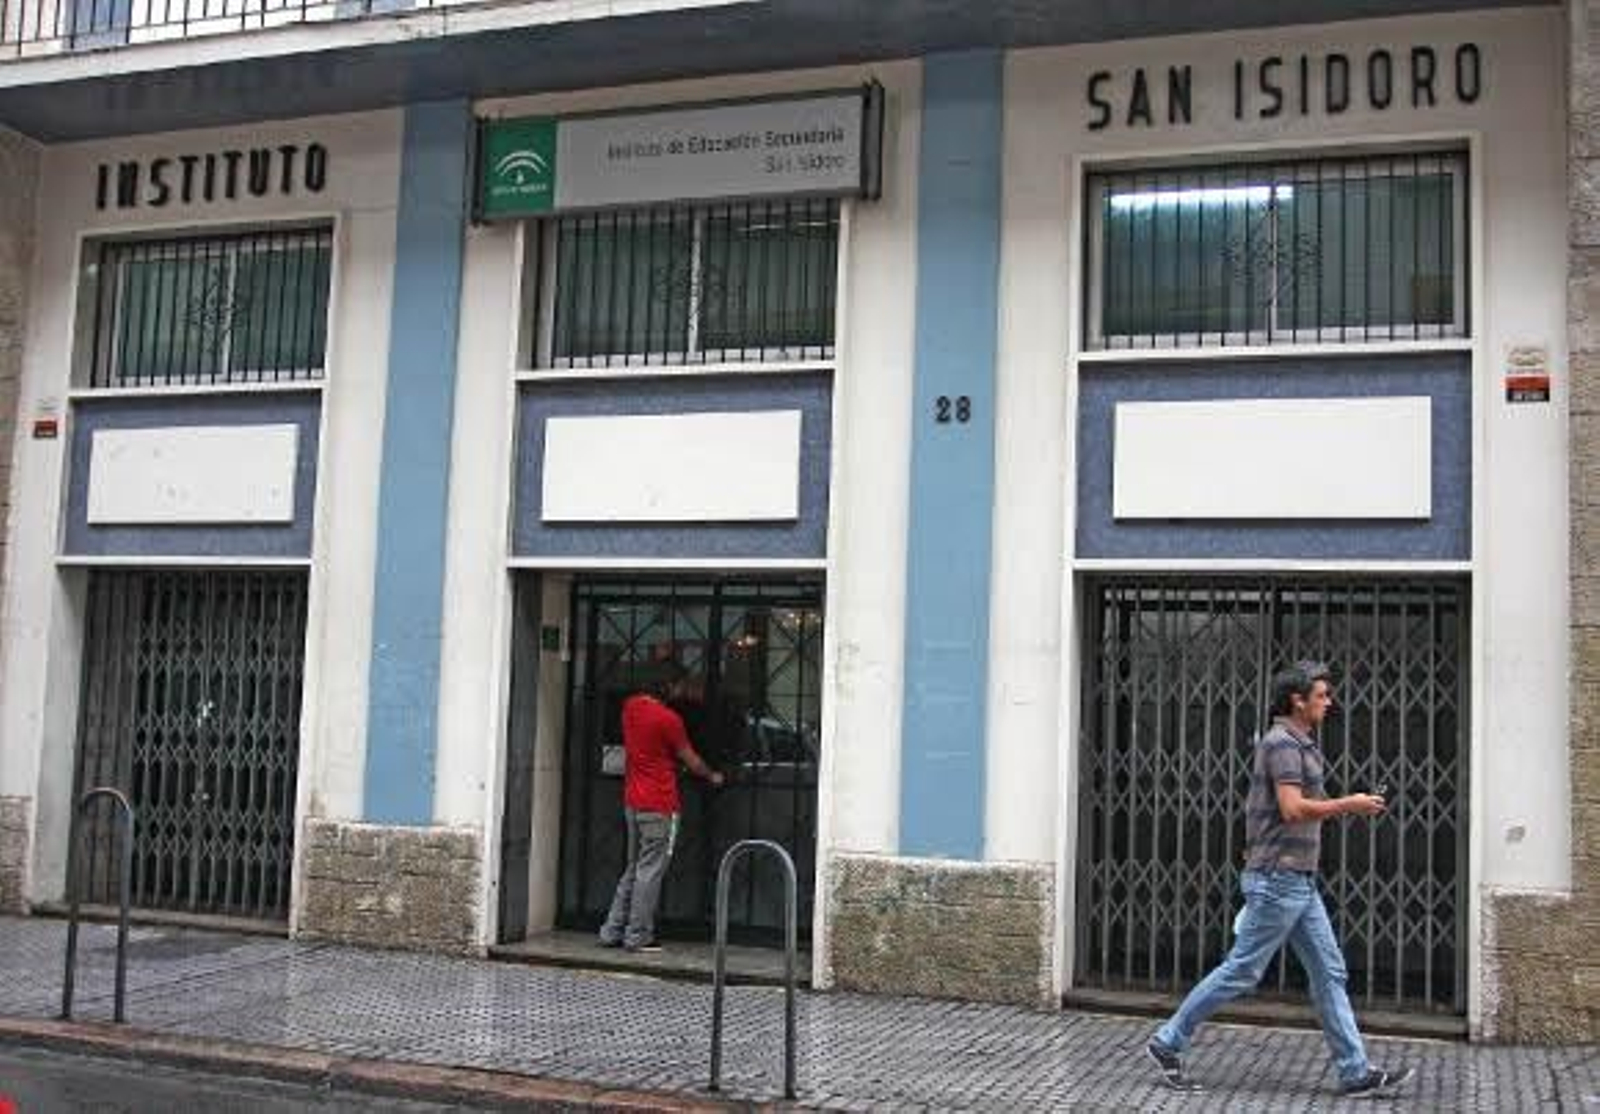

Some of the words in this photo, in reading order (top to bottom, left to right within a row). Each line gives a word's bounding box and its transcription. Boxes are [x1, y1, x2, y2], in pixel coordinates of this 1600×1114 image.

[1087, 64, 1192, 131] SAN
[1234, 42, 1481, 120] ISIDORO
[667, 142, 685, 155] de
[96, 142, 328, 211] INSTITUTO
[936, 395, 971, 423] 28
